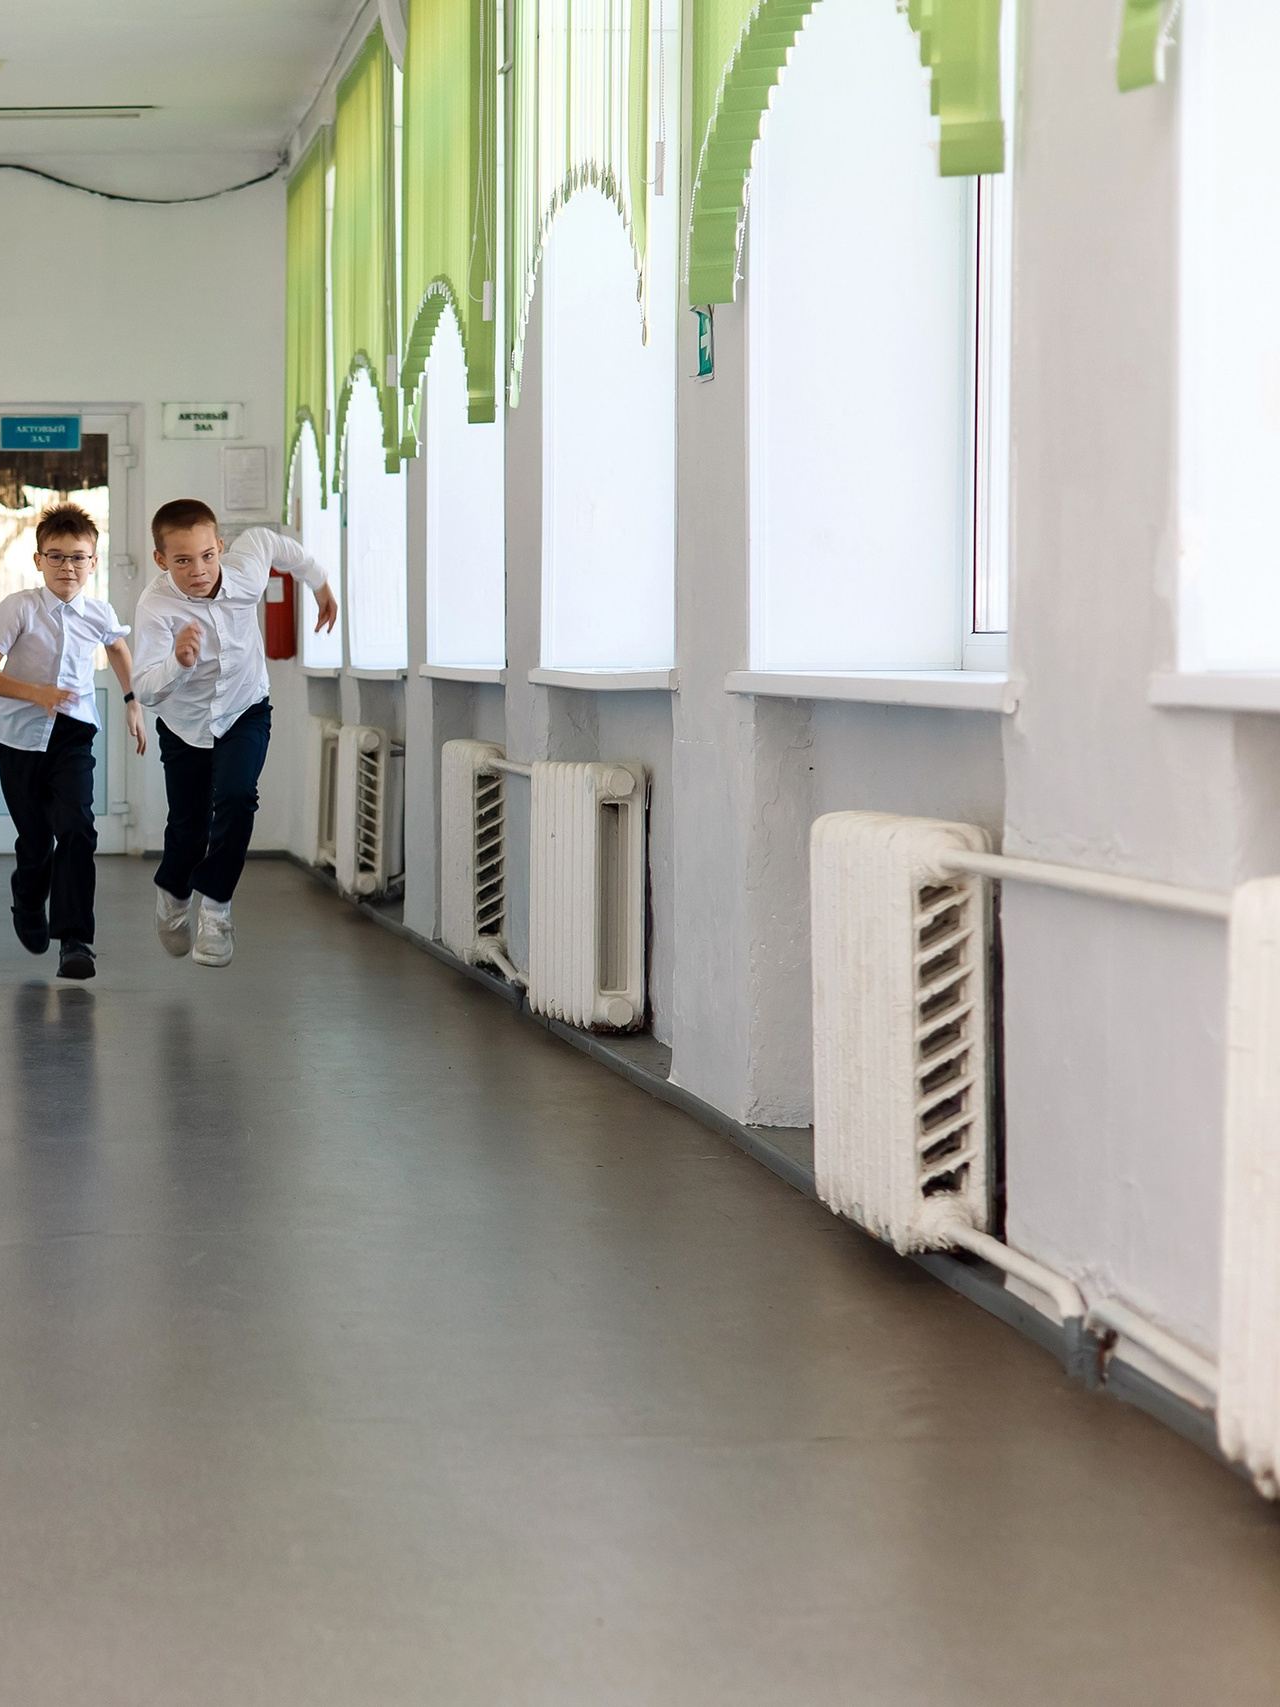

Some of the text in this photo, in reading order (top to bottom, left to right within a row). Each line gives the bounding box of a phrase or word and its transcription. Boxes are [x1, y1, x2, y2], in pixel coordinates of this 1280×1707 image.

[178, 411, 228, 421] АКТОВЫЙ
[16, 424, 66, 433] АКТОВЫЙ
[194, 424, 213, 432] ЗАЛ
[31, 435, 51, 443] ЗАЛ
